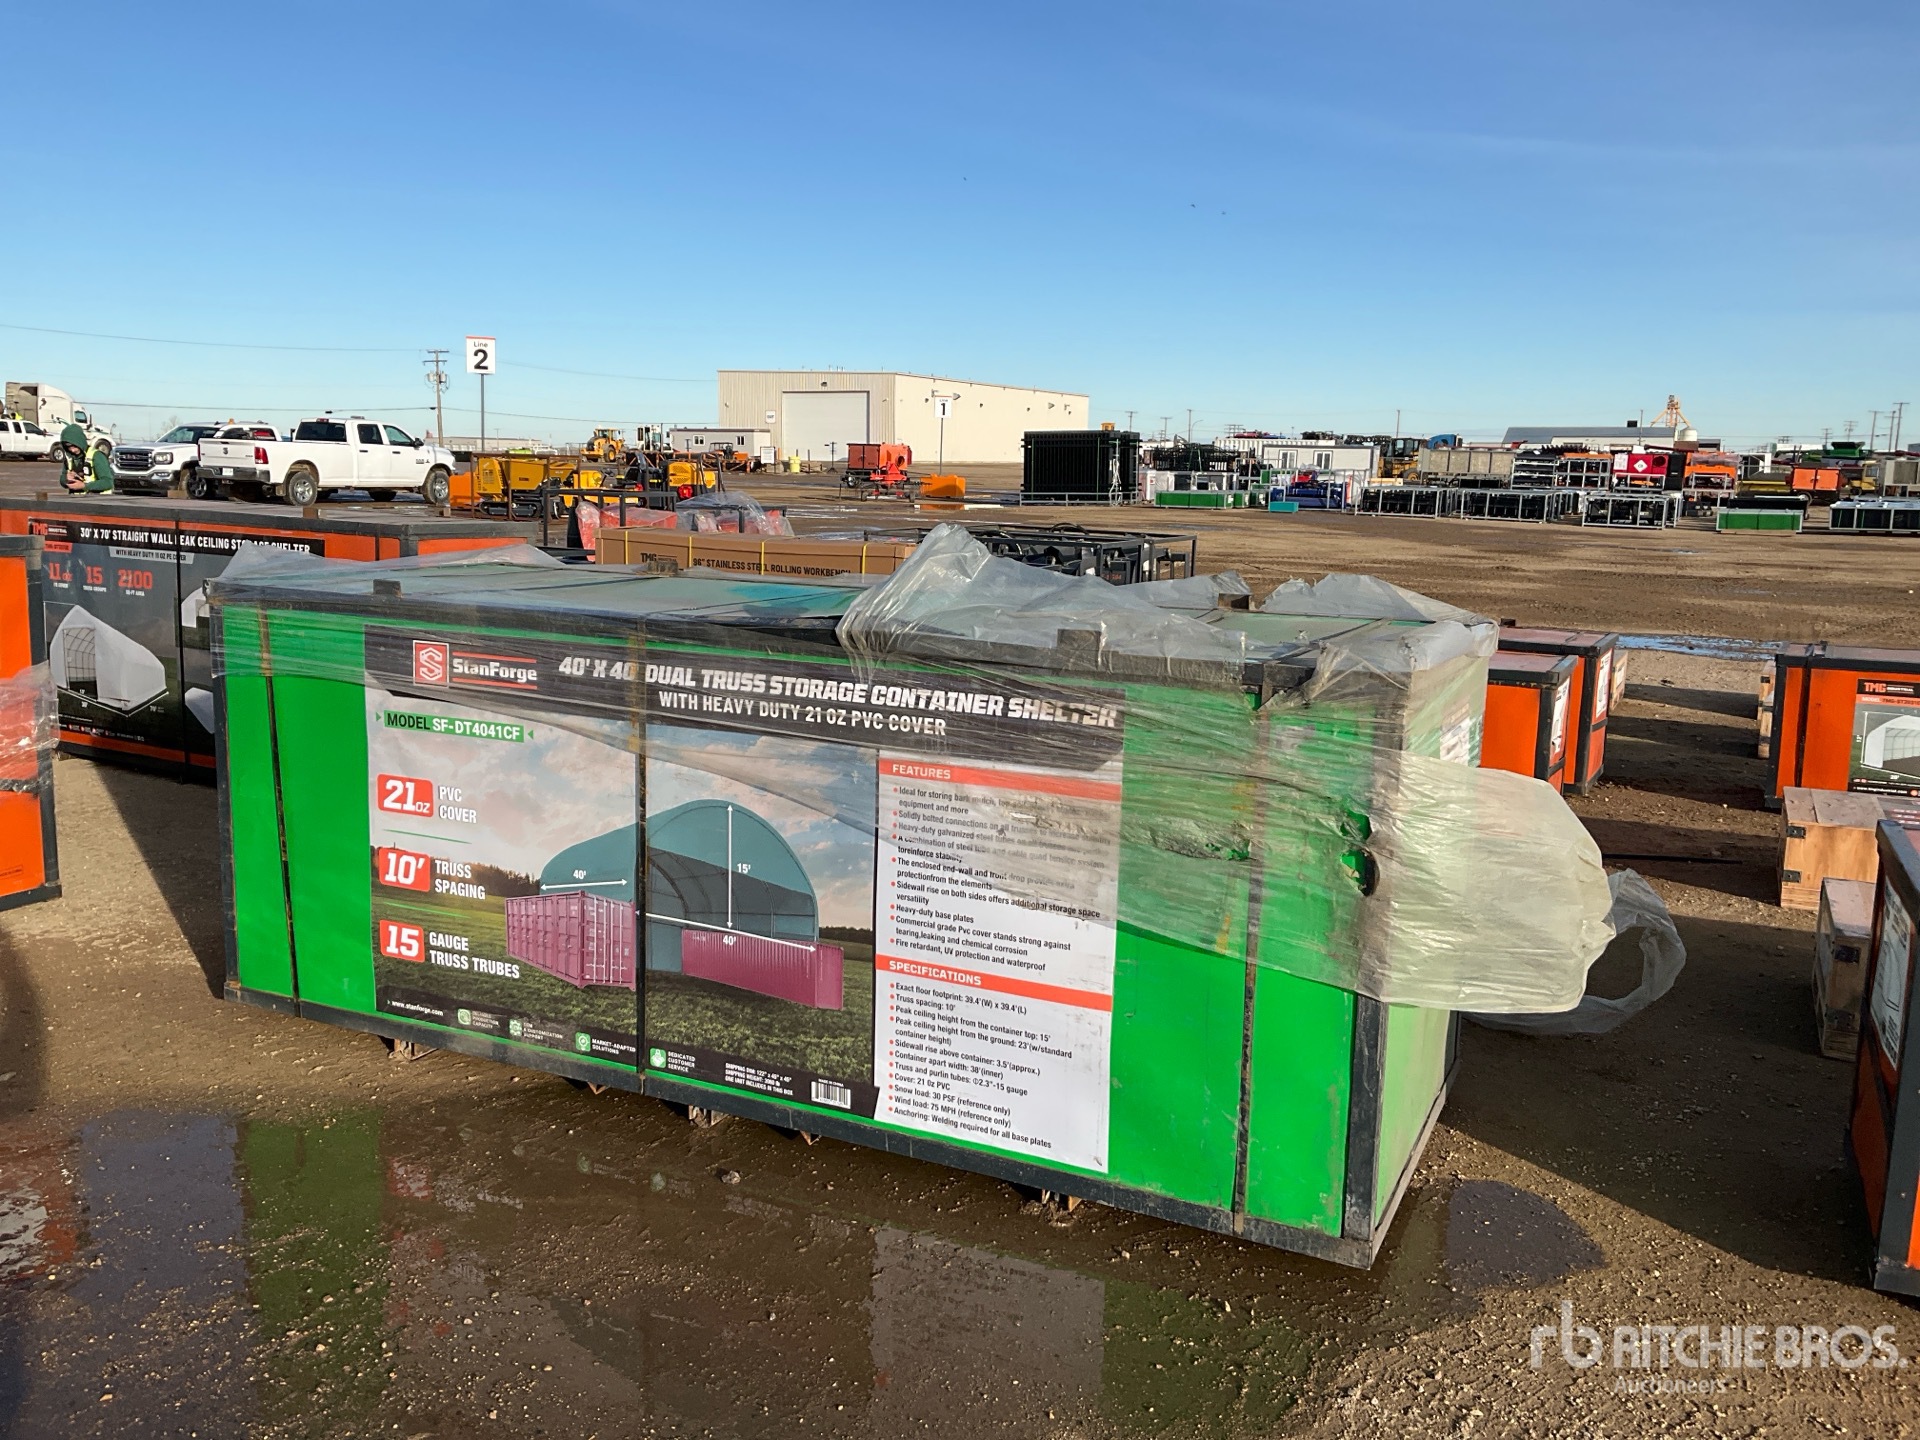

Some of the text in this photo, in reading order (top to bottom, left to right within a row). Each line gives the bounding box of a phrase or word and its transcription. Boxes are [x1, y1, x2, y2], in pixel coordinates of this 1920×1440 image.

[474, 348, 488, 370] 2
[941, 402, 946, 416] 1
[32, 522, 48, 536] TMG
[80, 528, 92, 538] 30'
[94, 529, 99, 539] X
[100, 529, 111, 540] 70'
[112, 530, 149, 543] STRAIGHT
[150, 532, 172, 544] WALL
[174, 534, 196, 547] EAK
[198, 536, 230, 549] CEILING
[640, 552, 657, 562] TMG
[706, 559, 746, 570] STAINLESS
[746, 562, 768, 572] STEL
[770, 564, 802, 574] ROLLING
[49, 562, 60, 580] 11
[86, 566, 104, 584] 15
[118, 568, 153, 590] 2100
[452, 658, 538, 682] StanForge
[558, 656, 590, 676] 40'
[592, 660, 608, 678] X
[645, 664, 696, 686] DUAL
[701, 668, 766, 694] TRUSS
[769, 675, 870, 704] STORAGE
[870, 684, 1004, 718] CONTAINER
[1008, 698, 1116, 728] SHELTER
[1864, 682, 1887, 692] TMG
[659, 690, 946, 736] WITH HEAVY DUTY 21 OZ PVC COVER
[387, 712, 520, 740] MODEL SF-DT4041CF
[892, 764, 951, 780] FEATURES
[438, 786, 462, 802] PVC
[439, 805, 477, 824] COVER
[384, 852, 426, 885] 10'
[434, 860, 472, 879] TRUSS
[573, 870, 586, 880] 40'
[737, 863, 751, 874] 15'
[896, 880, 925, 892] Sidewall
[926, 886, 939, 894] rise
[951, 890, 967, 898] both
[968, 892, 986, 902] sides
[988, 894, 1010, 904] offers
[1010, 900, 1047, 910] additional
[1048, 904, 1076, 915] storage
[1078, 908, 1101, 918] space
[896, 894, 930, 906] versatility
[896, 904, 974, 923] Heavy-duty base plates
[386, 925, 420, 957] 15
[429, 932, 469, 951] GAUGE
[722, 935, 736, 946] 40'
[896, 916, 1072, 950] Commercial grade Pvc cover stands strong against
[896, 938, 1046, 972] Fire retardant, UV protection and waterproof
[947, 936, 960, 944] and
[961, 938, 993, 950] chemical
[994, 944, 1028, 956] corrosion
[430, 950, 520, 979] TRUSS TRUBES
[889, 960, 982, 986] SPECIFICATIONS
[896, 982, 914, 992] Exact
[916, 986, 931, 994] floor
[932, 989, 964, 1002] footprint:
[896, 994, 914, 1004] Truss
[916, 998, 944, 1010] spacing:
[896, 1005, 1051, 1042] Peak ceiling height from the container top: 15'
[896, 1016, 912, 1026] Peak
[914, 1020, 936, 1032] ceiling
[938, 1024, 958, 1035] height
[960, 1028, 976, 1038] from
[978, 1033, 988, 1042] the
[990, 1036, 1016, 1048] ground:
[895, 1028, 952, 1046] container height)
[592, 1044, 620, 1054] SOLUTIONS
[668, 1051, 696, 1062] DEDICATED
[895, 1039, 924, 1051] Sidewall
[925, 1046, 938, 1054] rise
[940, 1049, 959, 1058] above
[960, 1052, 995, 1066] container:
[668, 1058, 695, 1068] CUSTOMER
[668, 1064, 688, 1072] SERVICE
[894, 1050, 927, 1064] Container
[928, 1058, 947, 1068] apart
[948, 1062, 969, 1072] width:
[894, 1084, 1011, 1116] Snow load: 30 PSF (reference only)
[894, 1096, 1012, 1128] Wind load: 75 MPH (reference only)
[894, 1106, 1052, 1148] Anchoring: Welding required for all base plates
